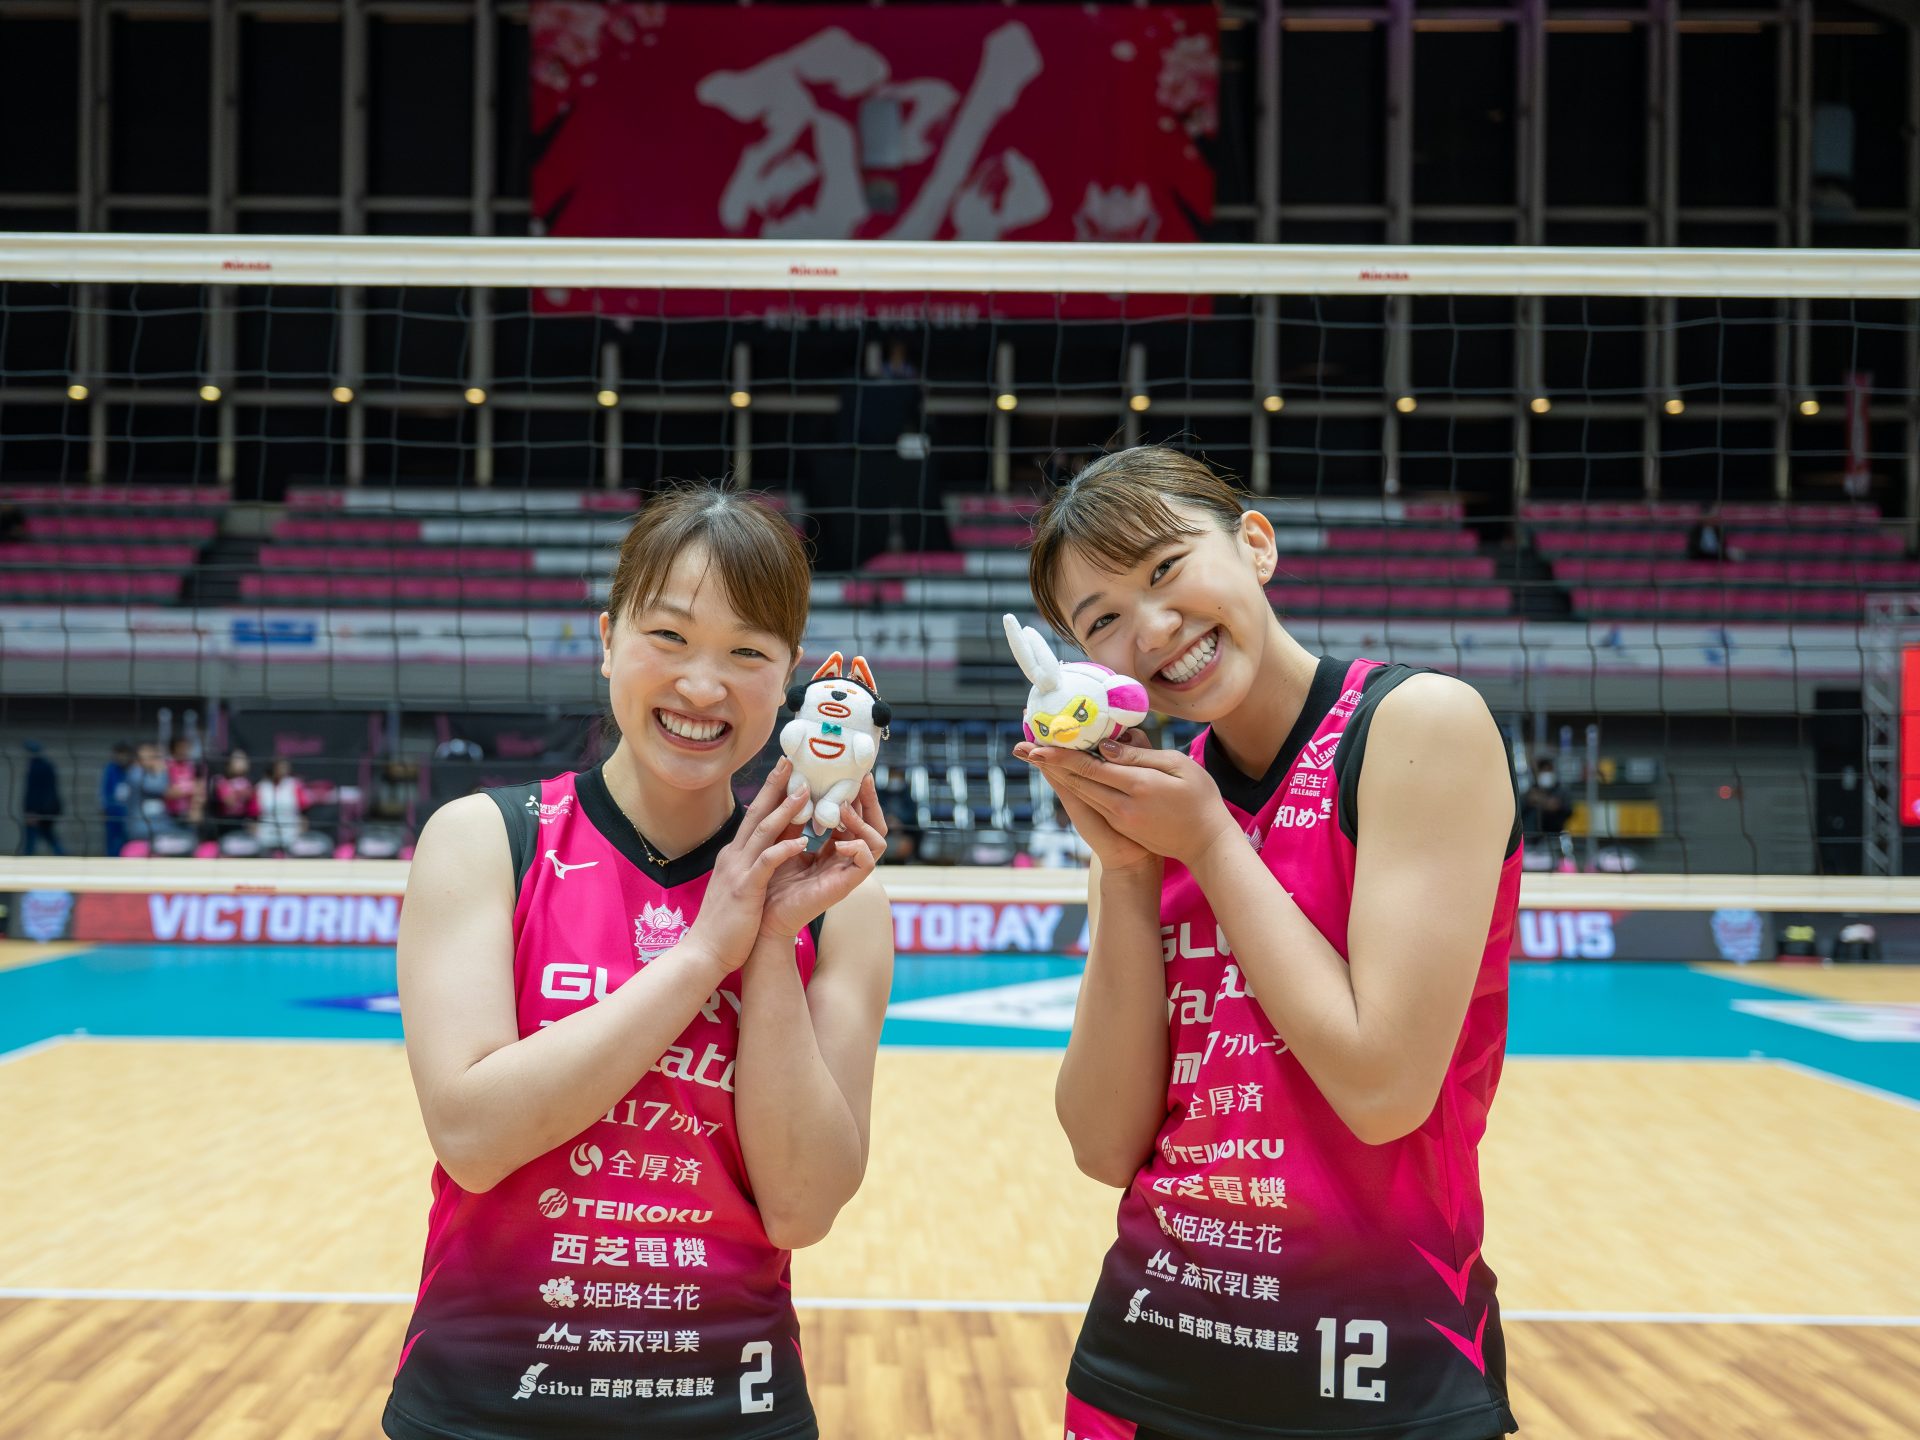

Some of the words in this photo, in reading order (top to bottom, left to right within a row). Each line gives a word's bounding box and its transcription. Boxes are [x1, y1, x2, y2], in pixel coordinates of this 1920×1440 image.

[148, 893, 396, 942] VICTORIN
[891, 903, 1064, 951] TORAY
[1519, 910, 1616, 959] U15
[608, 1149, 702, 1186] 全厚済
[573, 1197, 713, 1223] TEIKOKU
[551, 1233, 708, 1268] 西芝電機
[1172, 1212, 1283, 1254] 姫路生花
[582, 1280, 701, 1311] 姫路生花
[1181, 1262, 1280, 1302] 森永乳業
[536, 1342, 580, 1353] morinaga
[587, 1328, 700, 1353] 森永乳業
[1178, 1312, 1299, 1353] 西部電気建設
[739, 1340, 774, 1414] 2
[1315, 1317, 1389, 1403] 12
[590, 1377, 715, 1398] 西部電気建設
